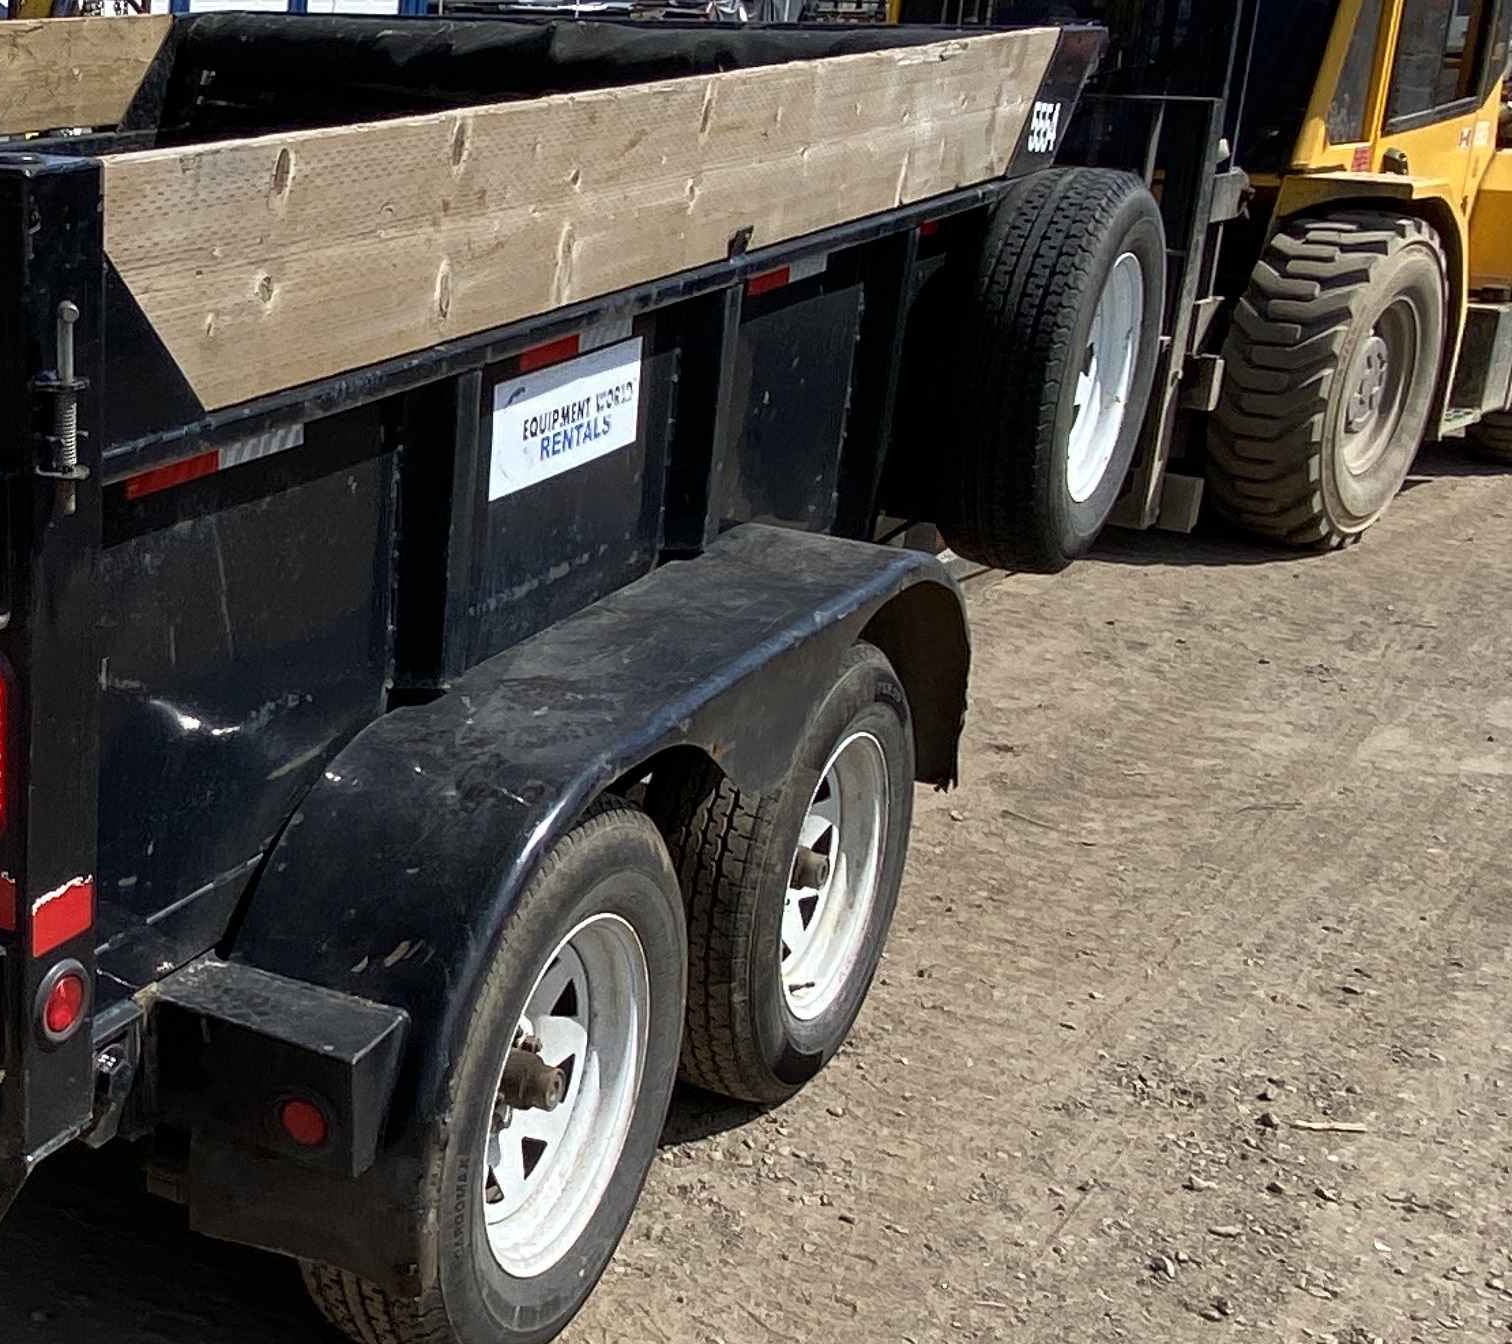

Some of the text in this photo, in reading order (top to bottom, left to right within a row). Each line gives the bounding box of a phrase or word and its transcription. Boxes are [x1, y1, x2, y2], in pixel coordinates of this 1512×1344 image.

[1027, 100, 1062, 153] 555A
[522, 396, 591, 441] EQUIPMENT
[540, 413, 613, 462] RENTALS
